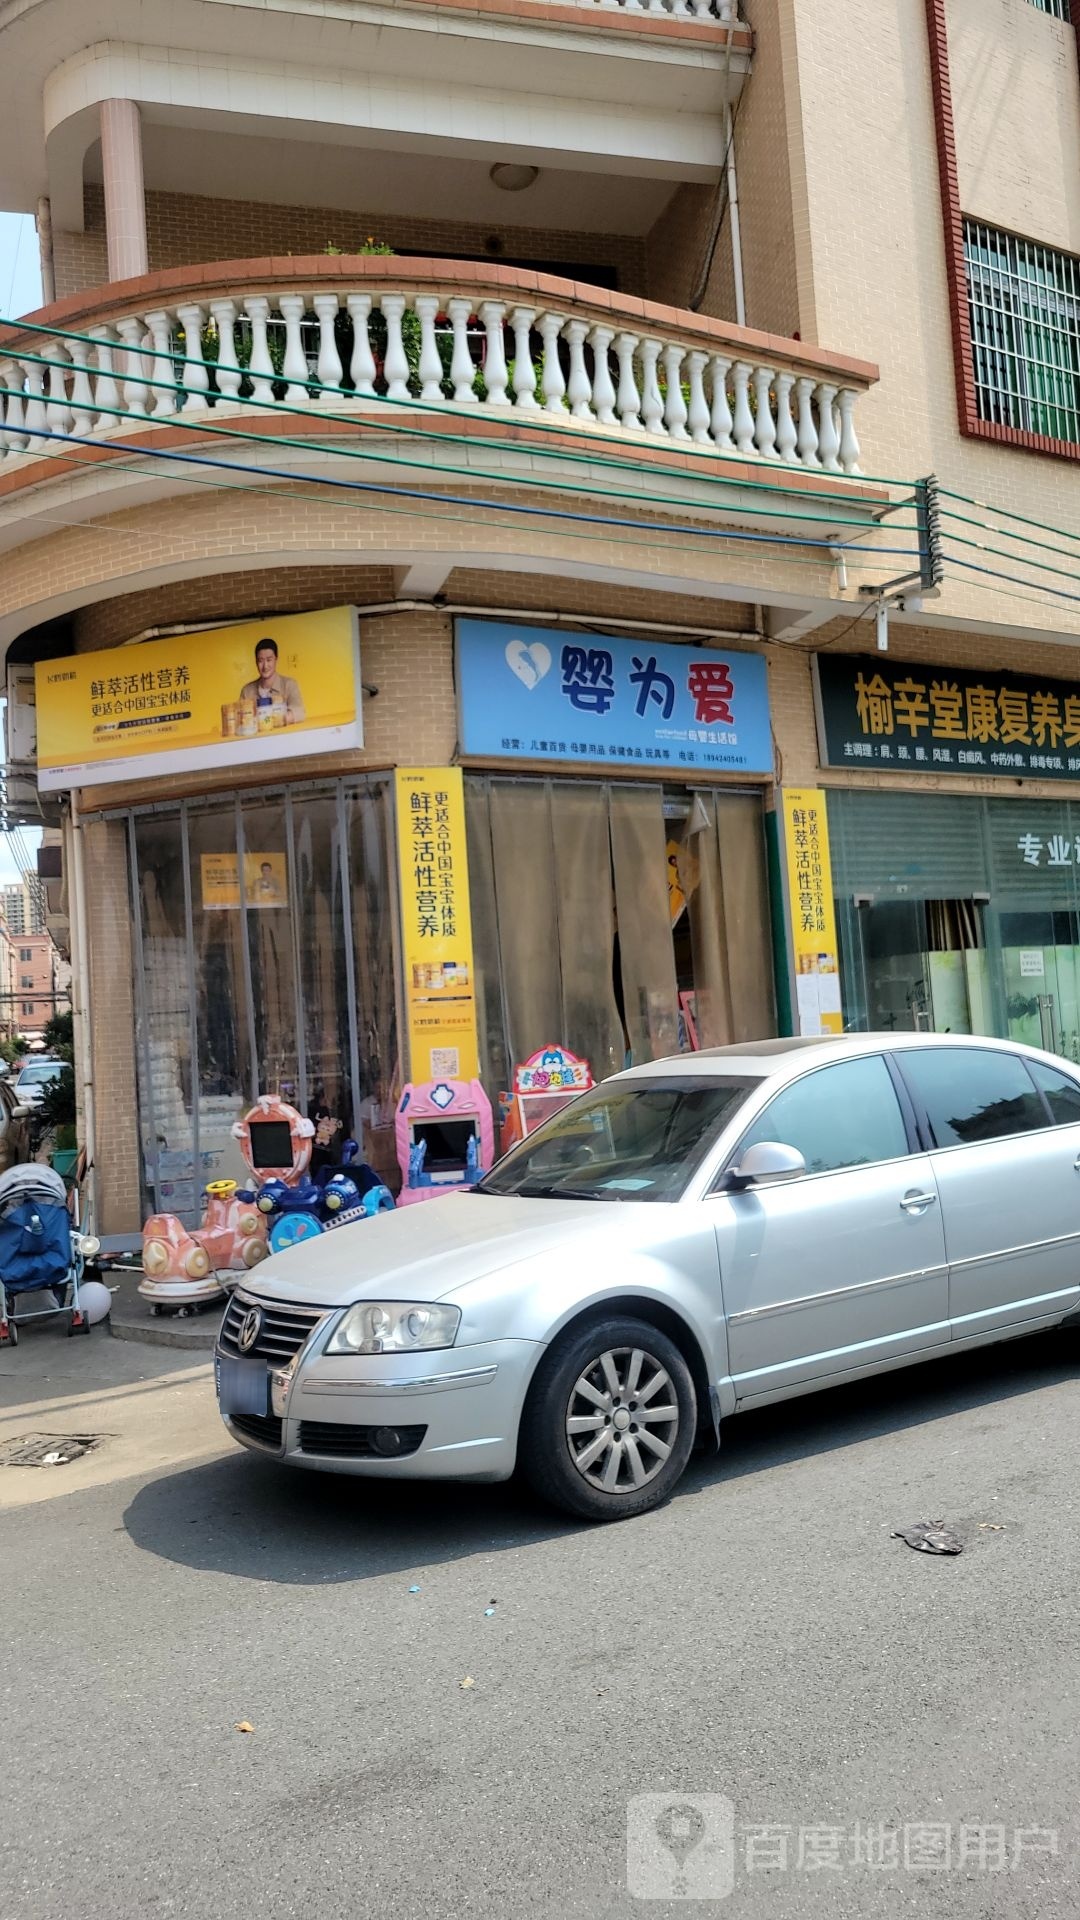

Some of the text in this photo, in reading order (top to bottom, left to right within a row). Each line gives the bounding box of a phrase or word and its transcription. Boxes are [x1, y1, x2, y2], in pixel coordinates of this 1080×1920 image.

[90, 665, 190, 700] 鲜萃活性营养
[91, 689, 191, 717] 更适合中国宝宝体质
[561, 645, 735, 724] 婴为爱
[410, 792, 439, 938] 鲜萃活性营养
[434, 791, 456, 937] 更适合中国宝宝体质
[792, 809, 815, 932] 鲜萃活性营养
[808, 809, 826, 932] 更适合中国宝宝体质
[1017, 833, 1080, 867] 专业
